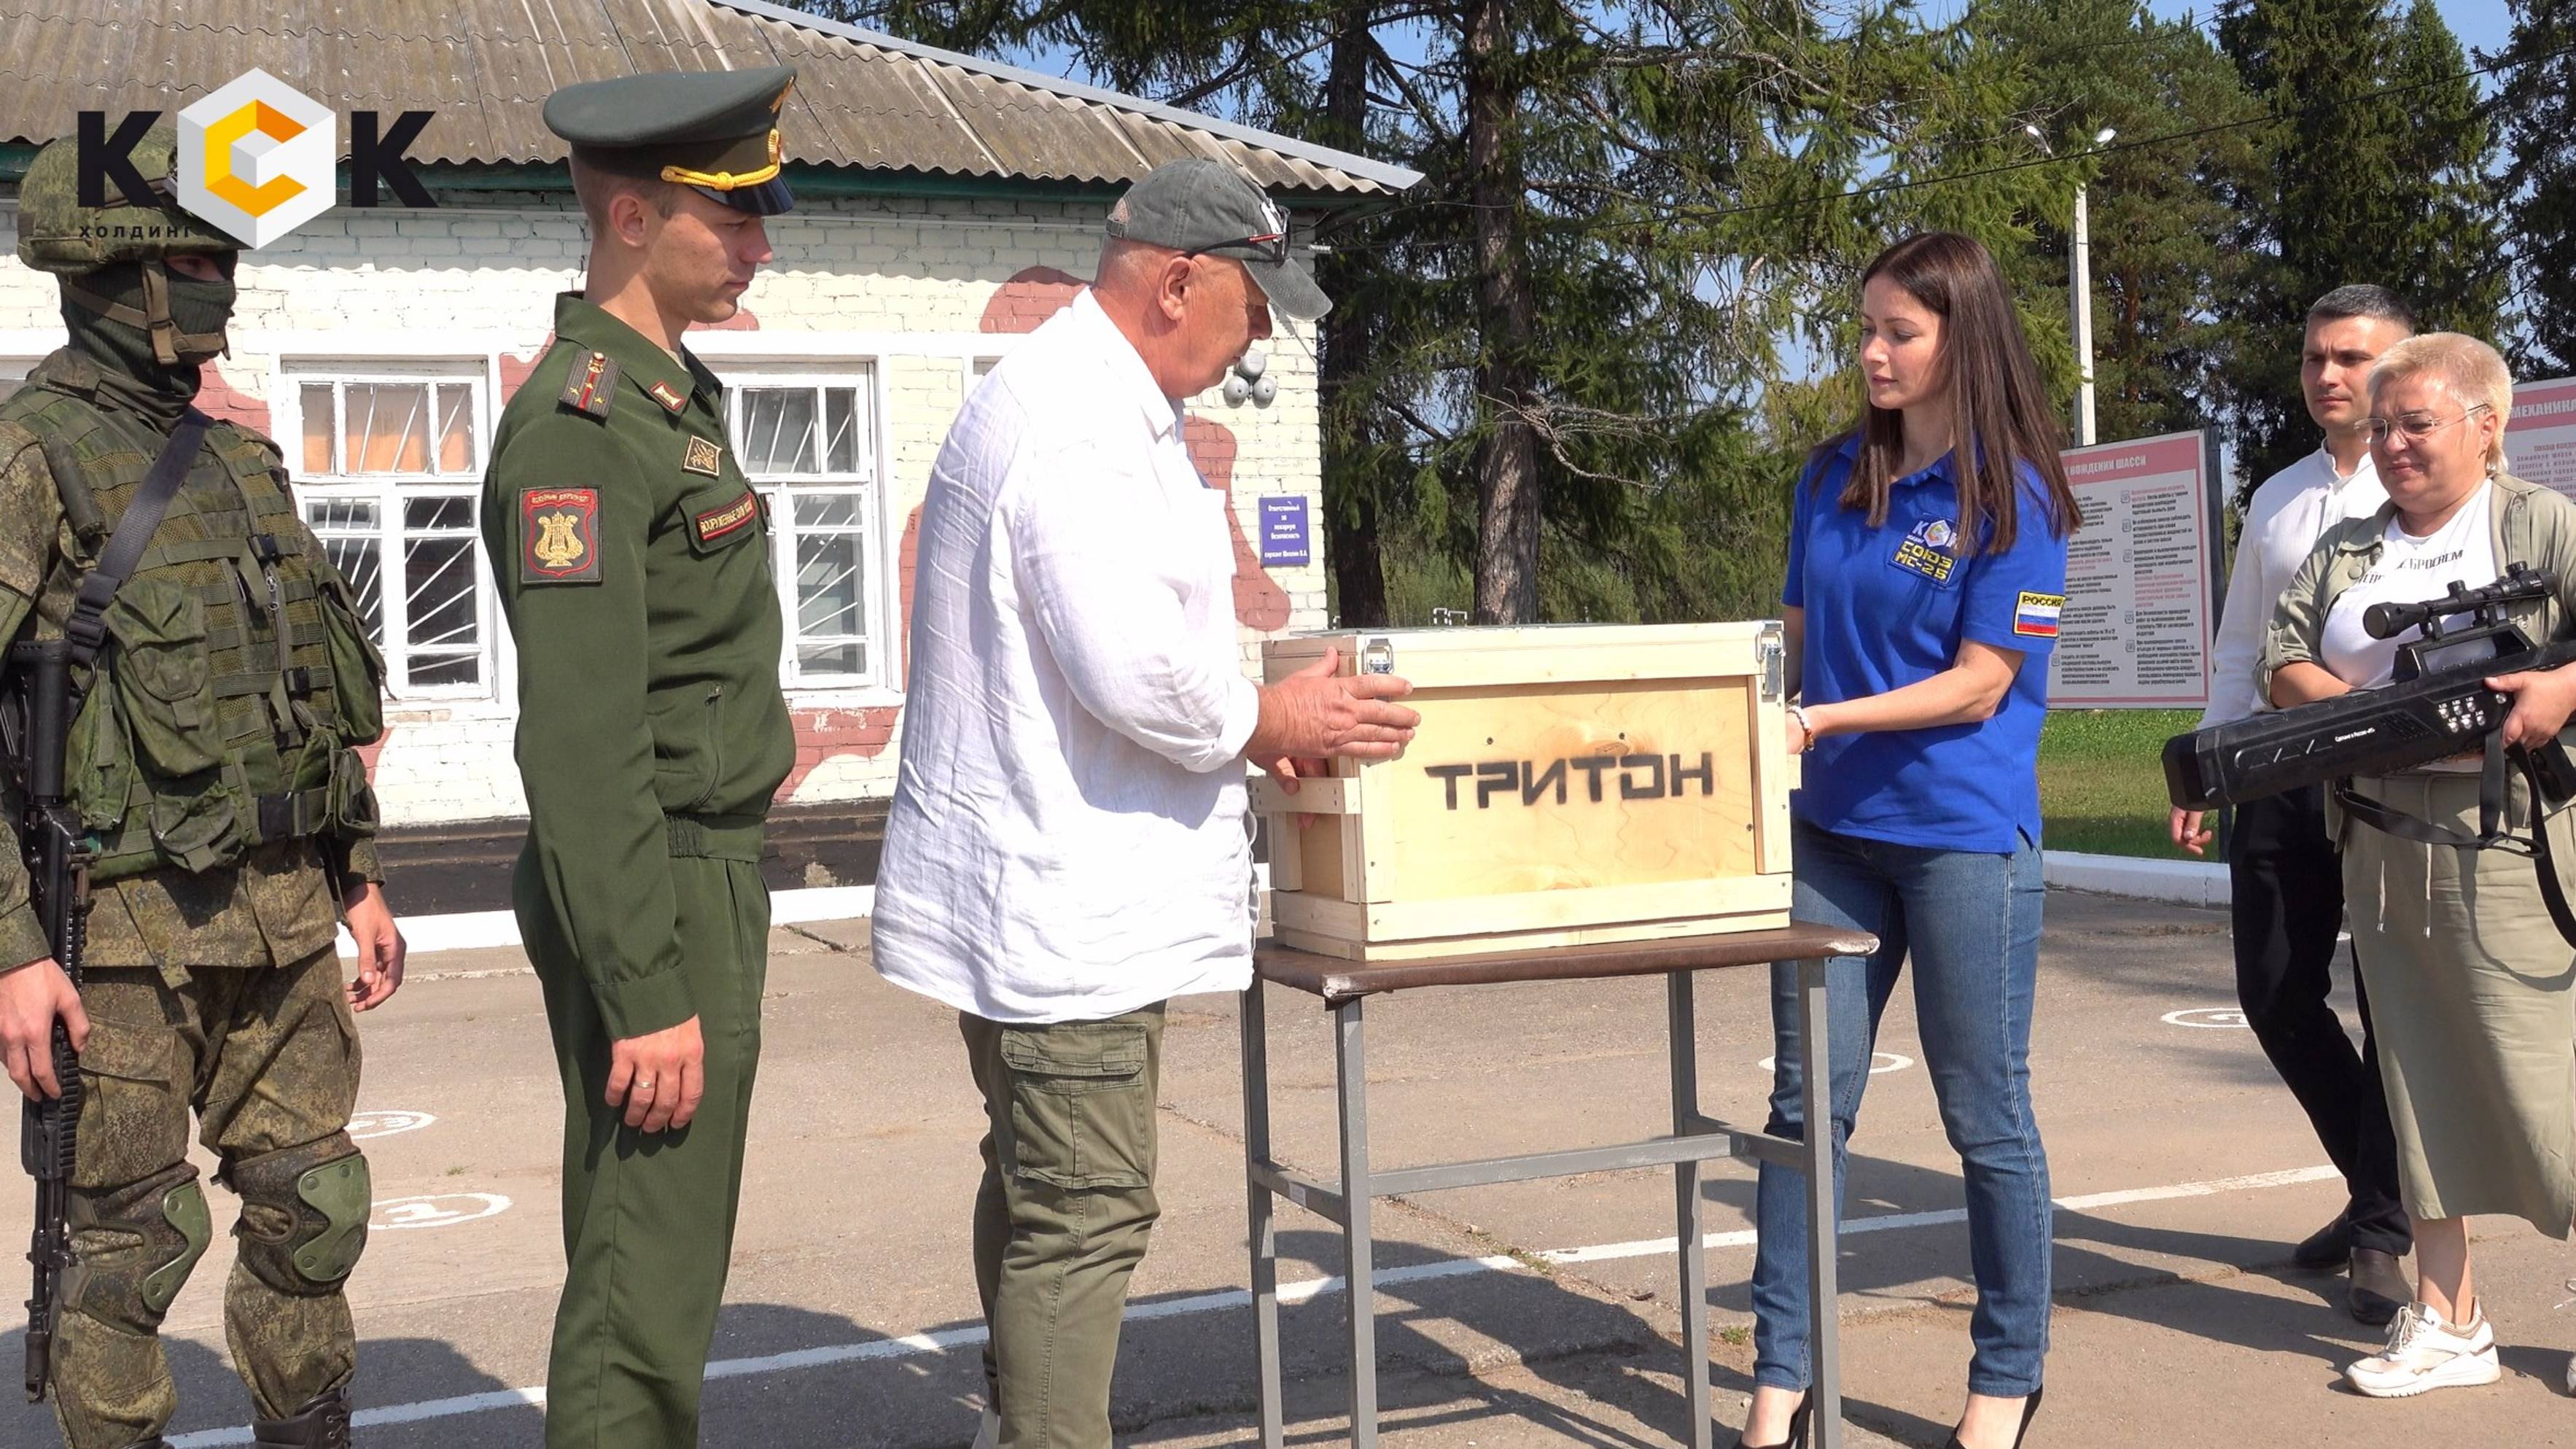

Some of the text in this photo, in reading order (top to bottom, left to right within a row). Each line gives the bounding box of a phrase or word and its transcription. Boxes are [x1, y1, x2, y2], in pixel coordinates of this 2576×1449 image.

[2070, 459, 2115, 475] ВОЖДЕНИИ
[2115, 455, 2147, 469] ШАССИ
[1894, 551, 1949, 580] МС-25
[1901, 540, 1953, 569] СОЮЗ
[2022, 595, 2063, 607] РОССИЯ
[1425, 751, 1713, 811] ТРИТОН
